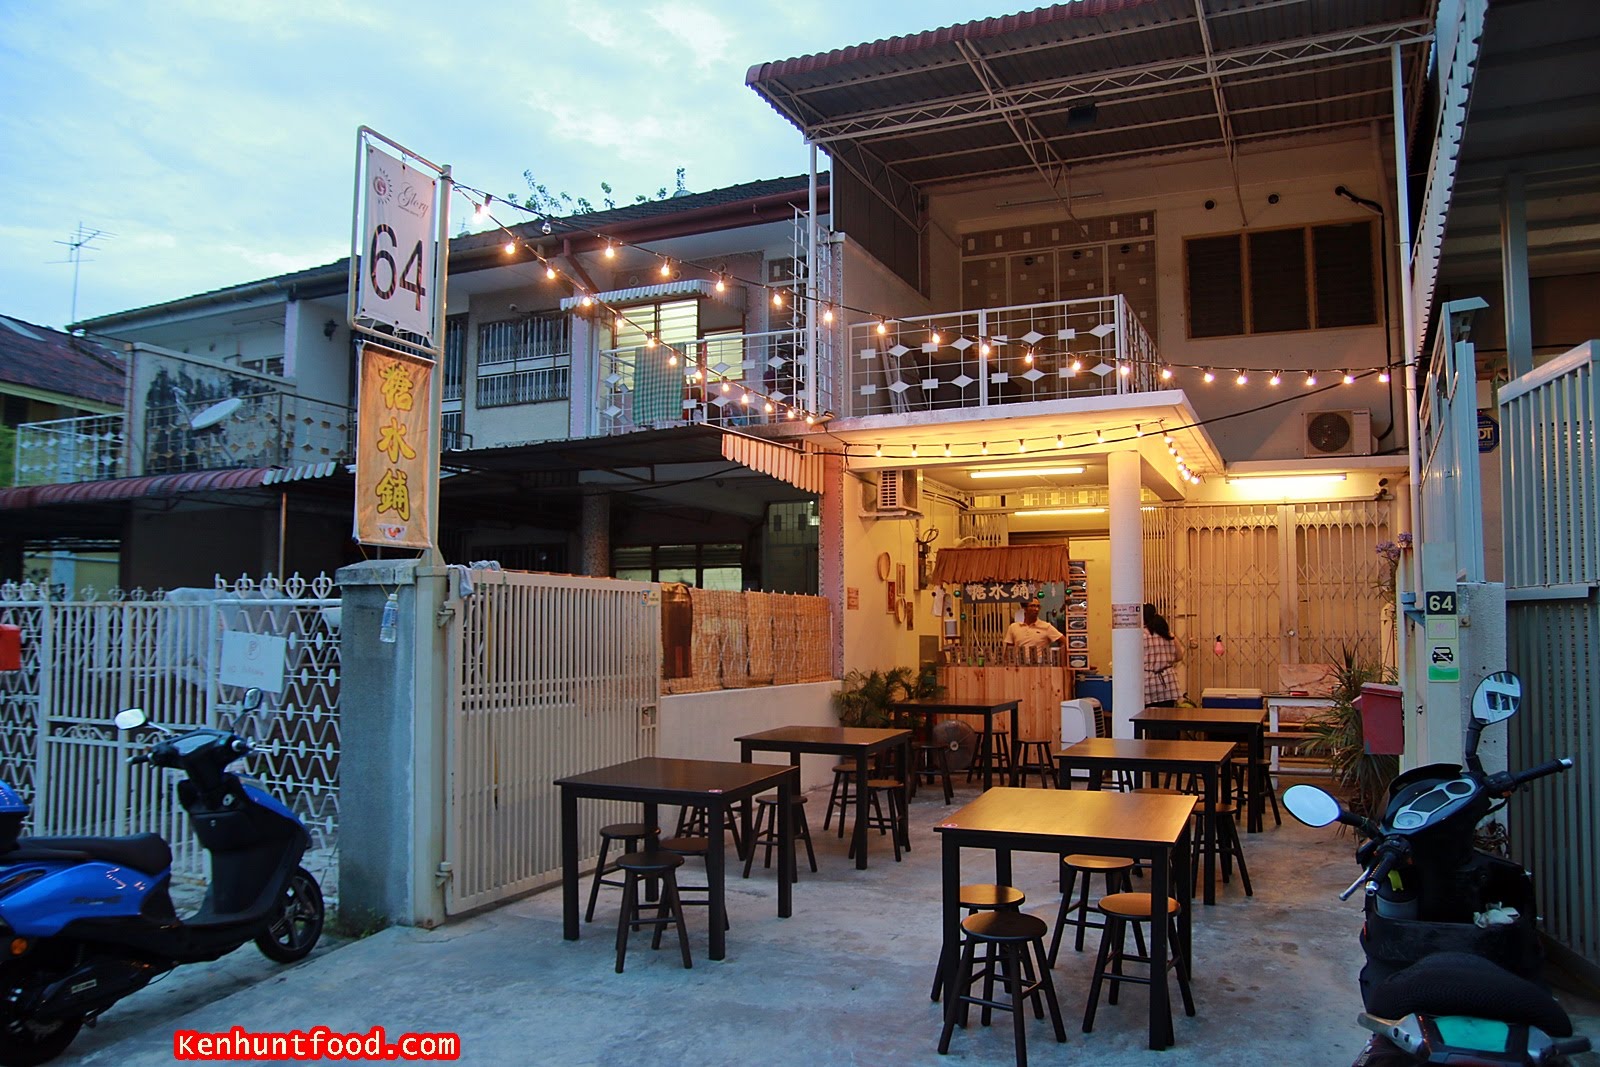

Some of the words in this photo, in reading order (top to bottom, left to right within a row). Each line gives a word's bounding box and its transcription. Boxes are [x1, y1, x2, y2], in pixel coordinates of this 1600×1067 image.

[397, 181, 429, 219] Glory
[370, 223, 427, 312] 64
[376, 362, 417, 522] 糖水鋪
[1428, 594, 1454, 612] 64
